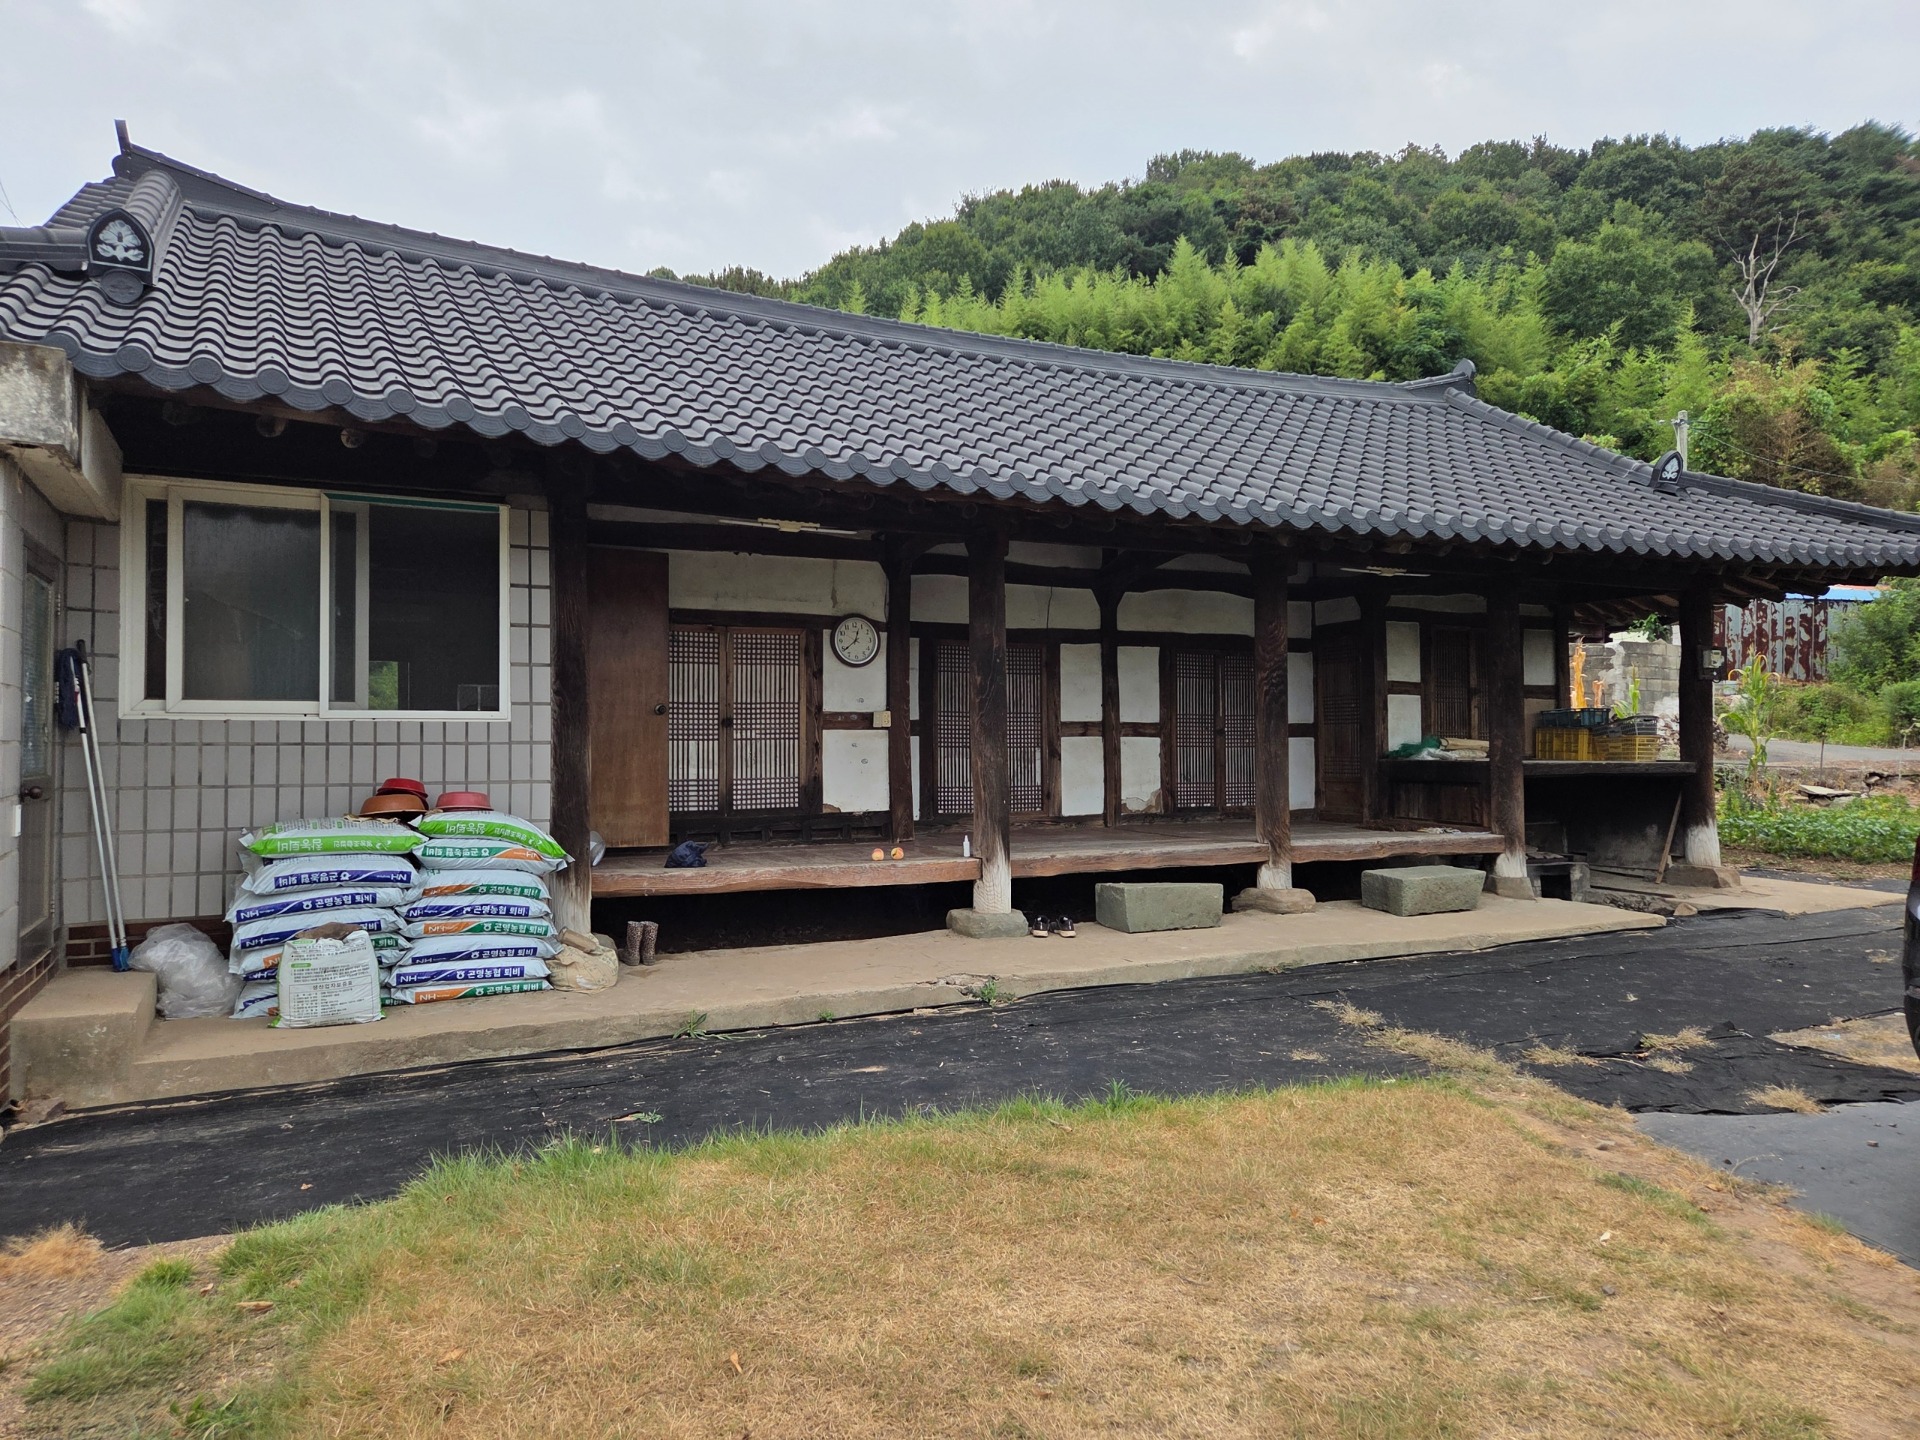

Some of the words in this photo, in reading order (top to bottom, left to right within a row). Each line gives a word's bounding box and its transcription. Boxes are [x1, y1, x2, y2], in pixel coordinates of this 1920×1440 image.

[446, 822, 486, 835] 참농퇴비
[277, 838, 323, 852] 참농퇴비
[333, 839, 373, 848] 영농조합법인
[426, 847, 443, 856] 퇴비
[279, 875, 298, 888] 퇴비
[390, 872, 407, 882] NH
[524, 887, 538, 897] 퇴비
[240, 910, 260, 920] NH
[355, 893, 373, 904] 퇴비
[409, 908, 424, 917] NH
[508, 905, 526, 915] 퇴비
[529, 924, 546, 935] 퇴비
[518, 947, 534, 957] 퇴비
[400, 975, 417, 983] NH
[467, 967, 501, 978] 곤명농협
[503, 966, 521, 977] 퇴비
[419, 993, 437, 1001] NH
[524, 983, 539, 992] 퇴비
